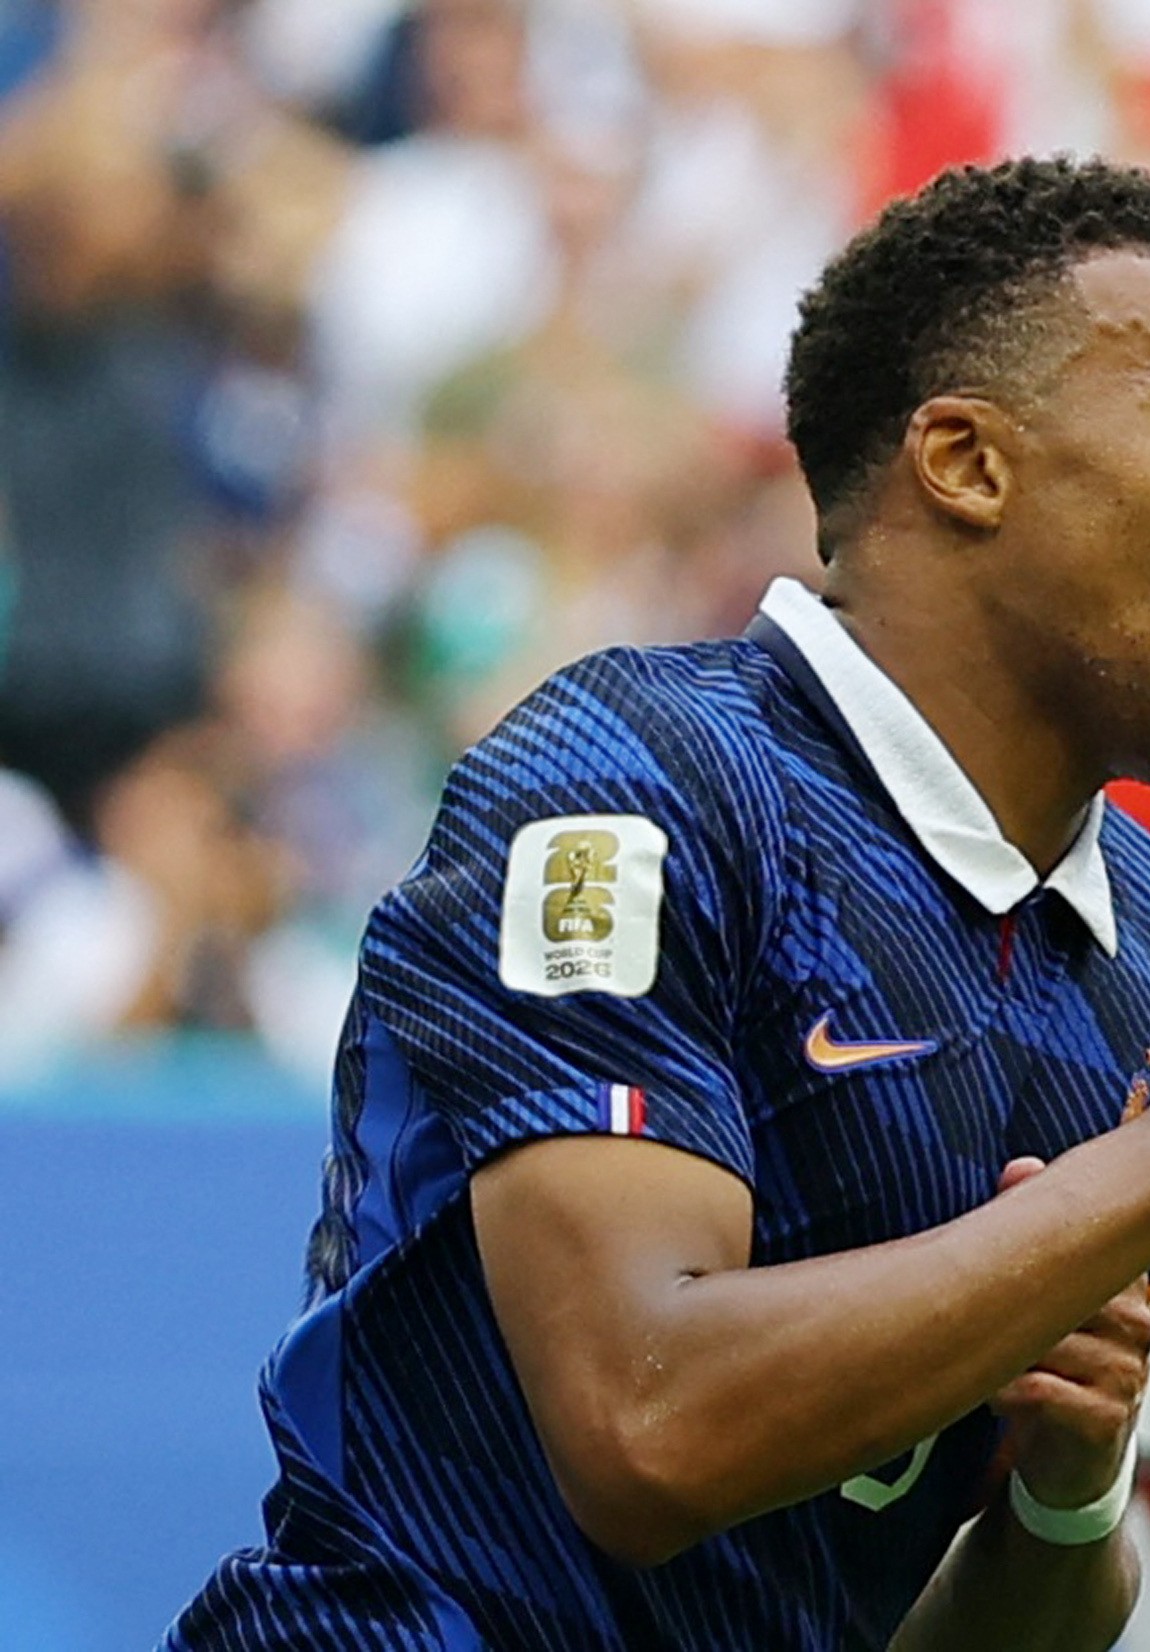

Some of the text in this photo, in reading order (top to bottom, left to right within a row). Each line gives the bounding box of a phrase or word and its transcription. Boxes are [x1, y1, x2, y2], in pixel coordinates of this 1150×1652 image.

[558, 918, 594, 933] FIFA
[544, 948, 613, 961] WORLD CUP
[545, 960, 612, 981] 2026
